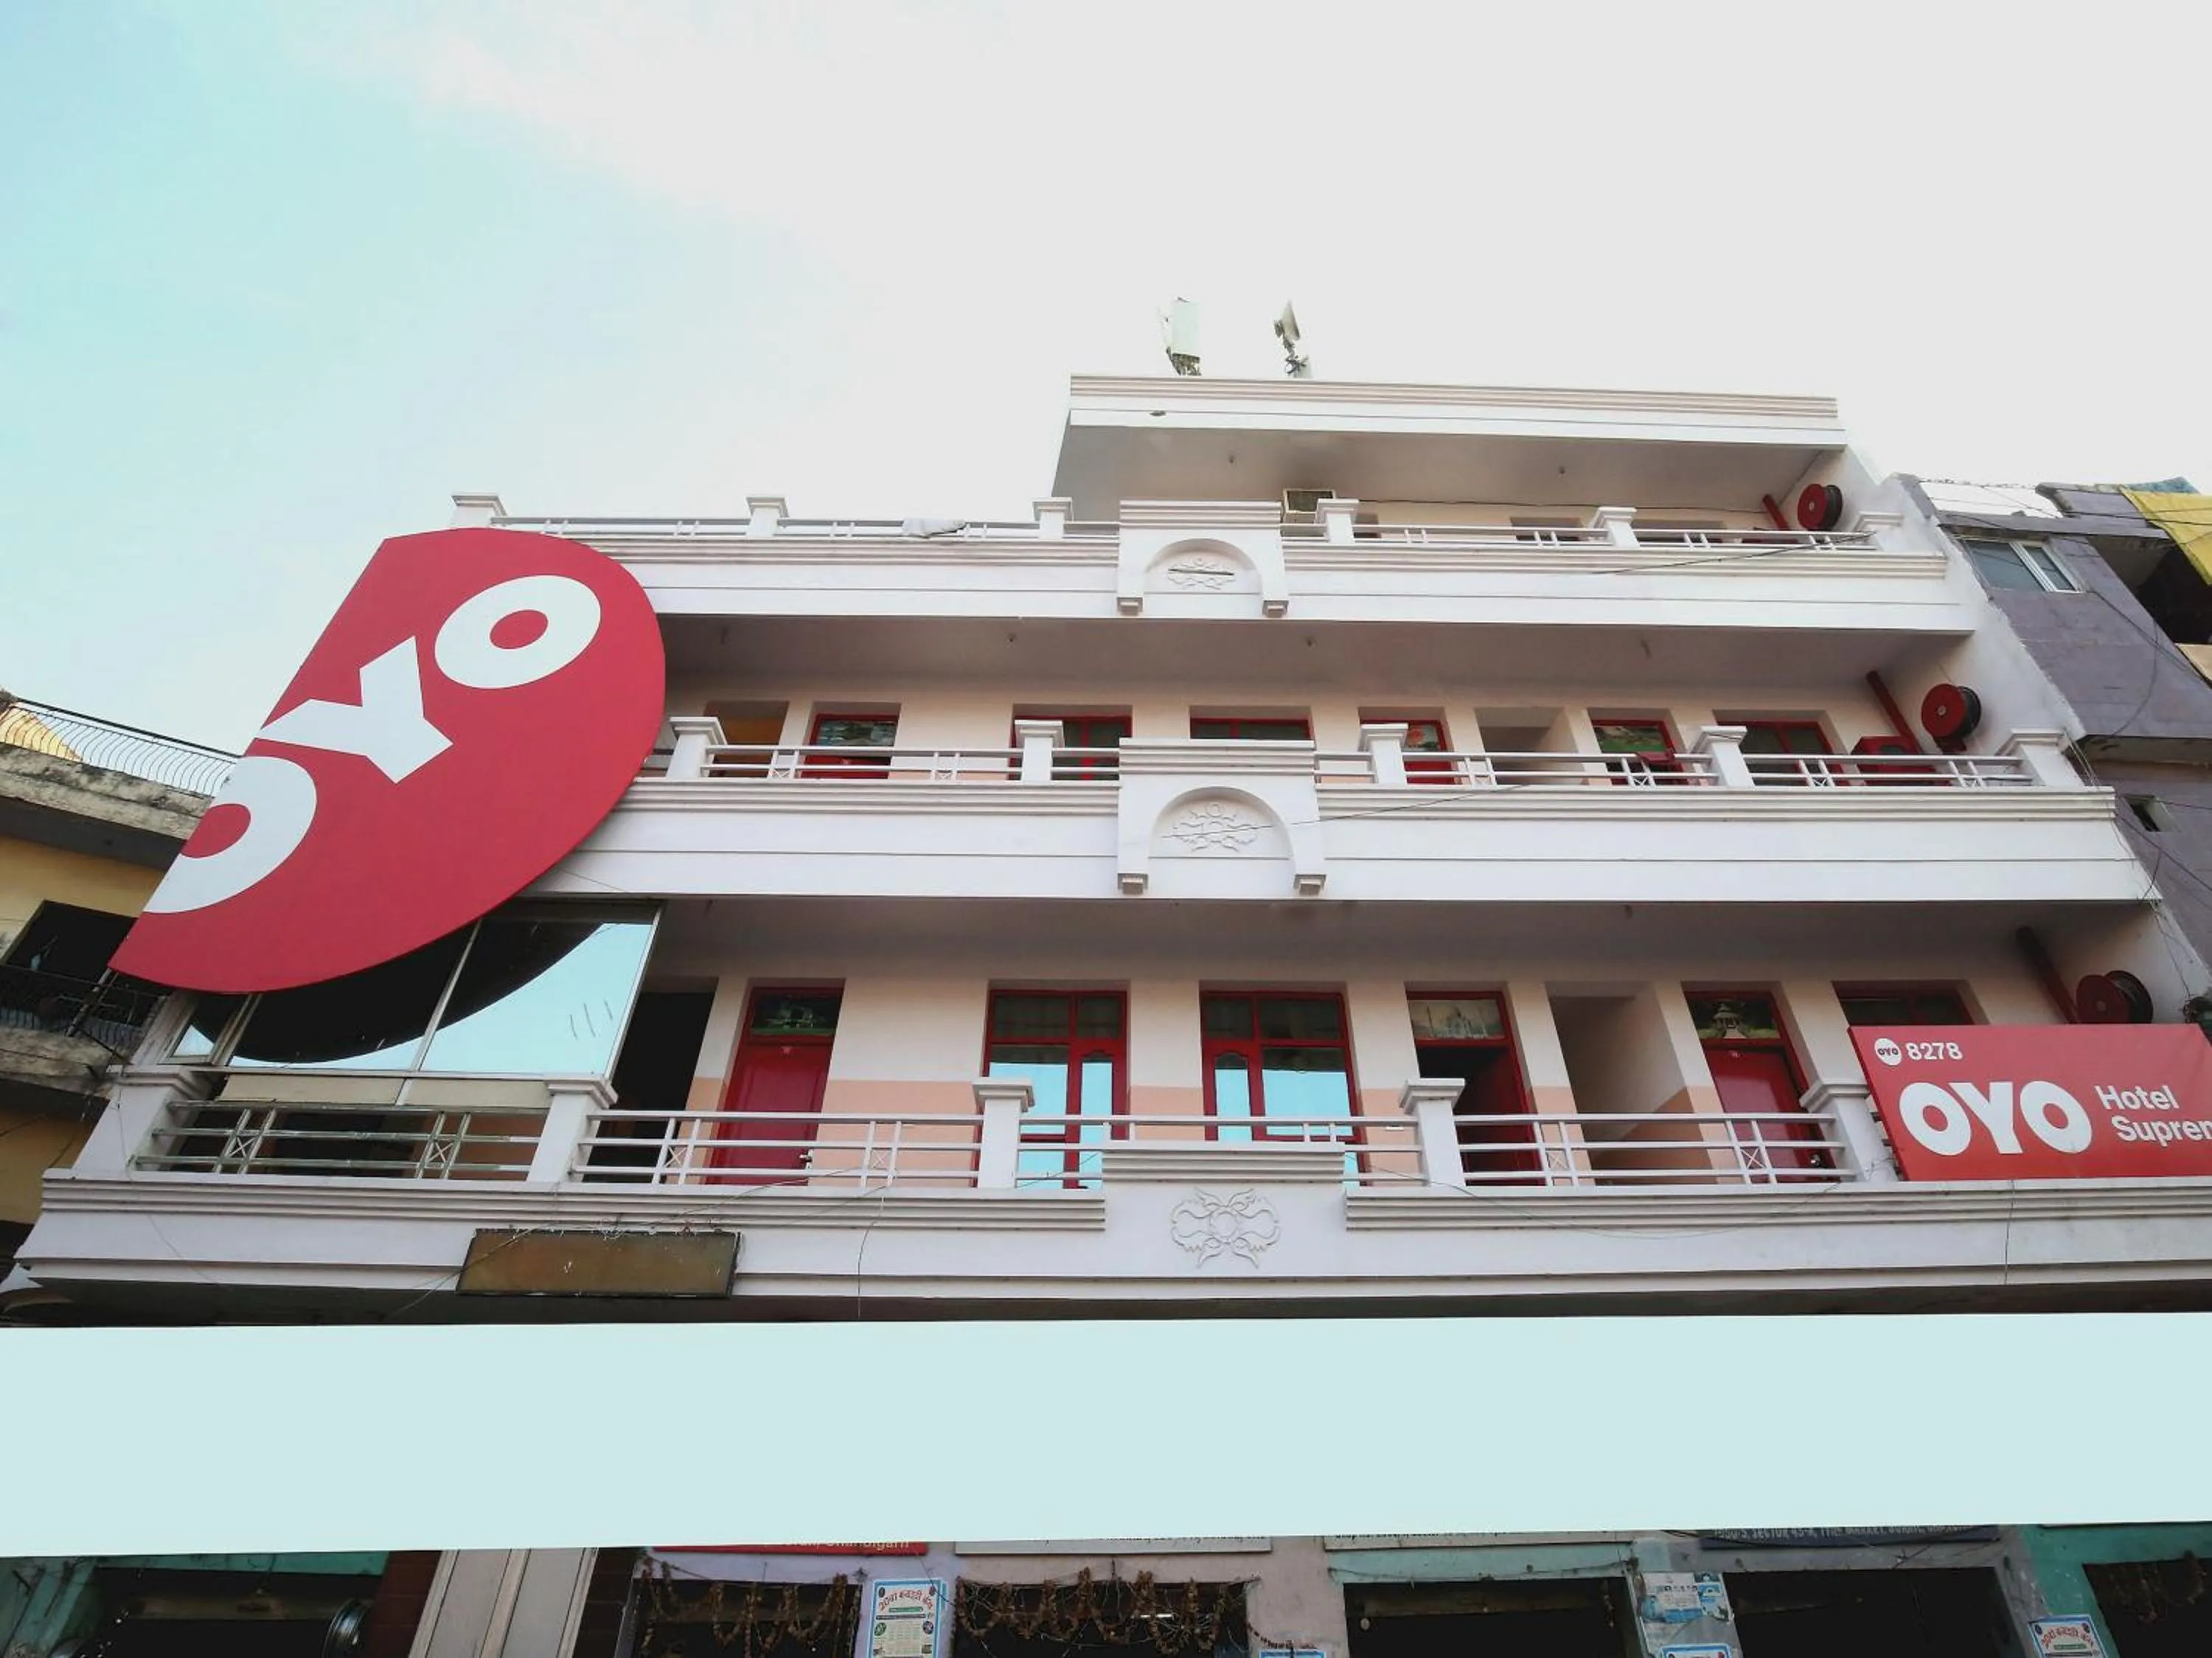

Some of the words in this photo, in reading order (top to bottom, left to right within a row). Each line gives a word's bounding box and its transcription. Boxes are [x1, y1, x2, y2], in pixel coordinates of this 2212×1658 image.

[1905, 1042, 1963, 1060] 8278
[2094, 1084, 2180, 1110] Hotel
[1899, 1081, 2093, 1156] OYO
